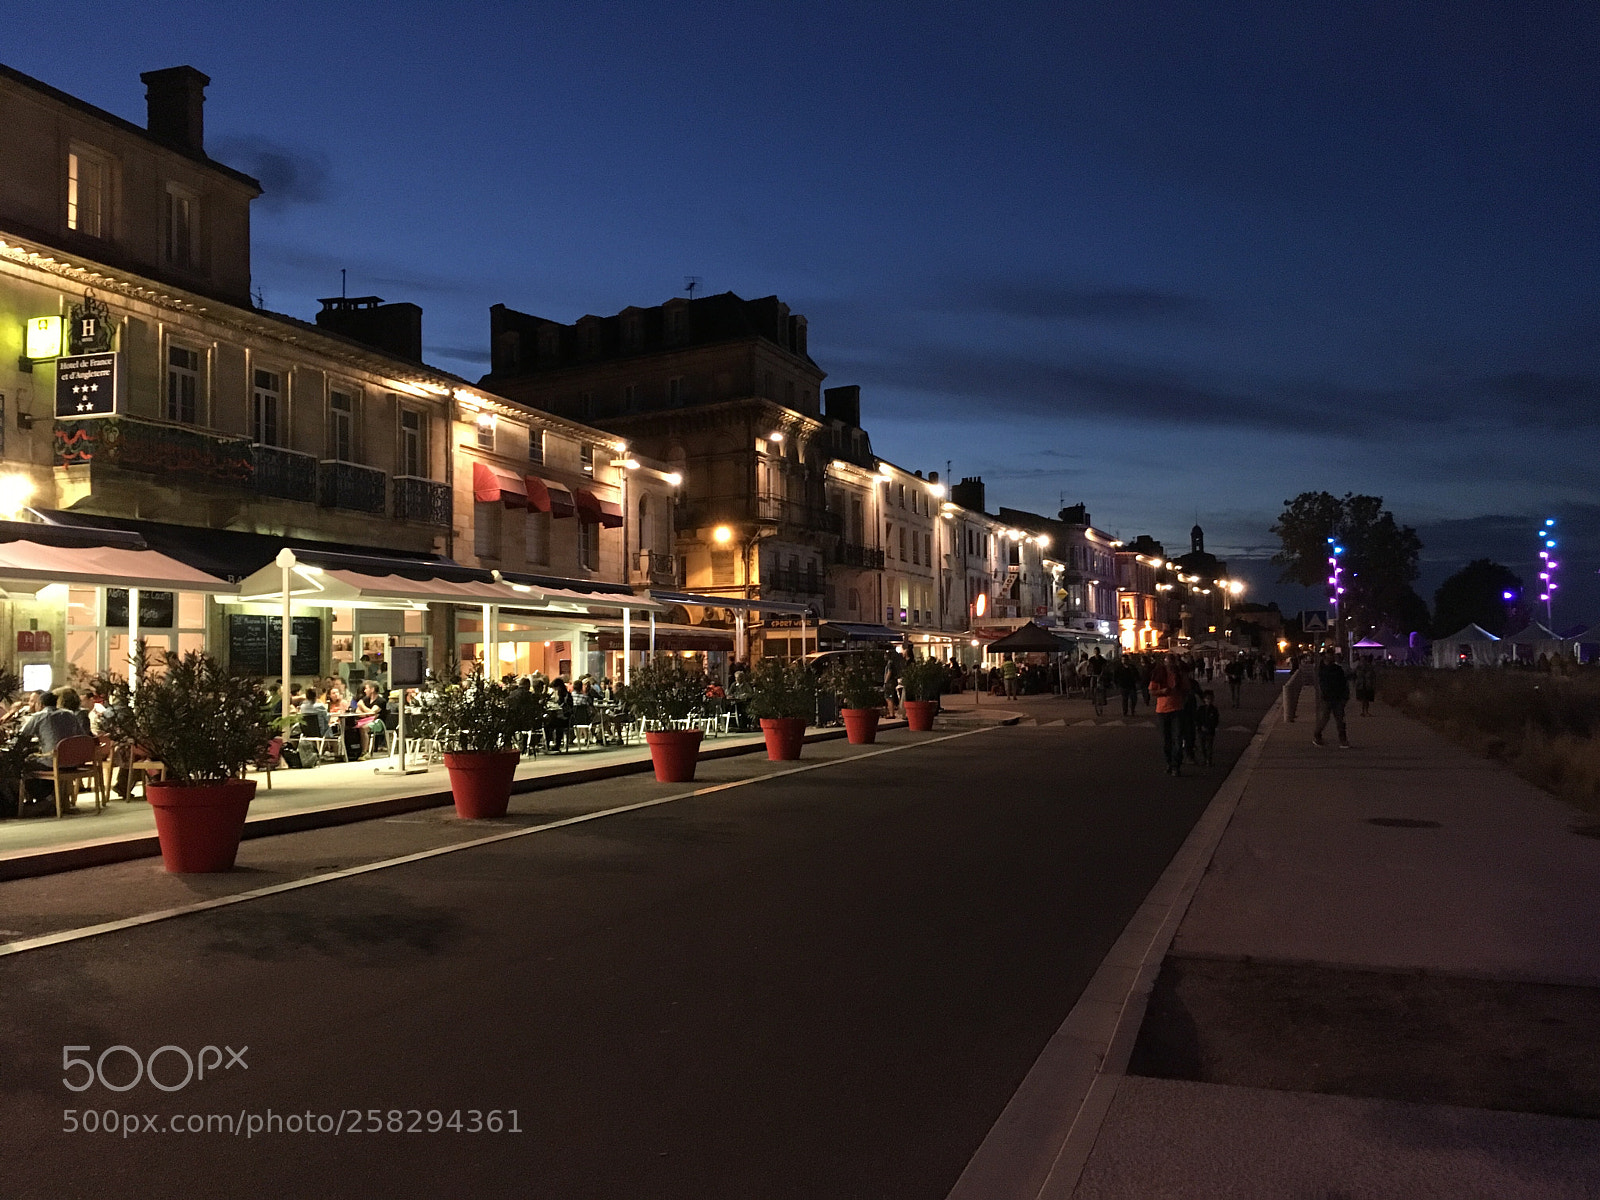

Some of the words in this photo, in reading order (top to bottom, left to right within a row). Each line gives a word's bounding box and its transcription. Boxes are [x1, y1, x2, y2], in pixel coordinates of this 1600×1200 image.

[82, 319, 95, 337] H
[80, 360, 89, 368] de
[90, 358, 113, 367] France
[61, 373, 69, 381] et
[69, 370, 111, 380] d'Angleterre
